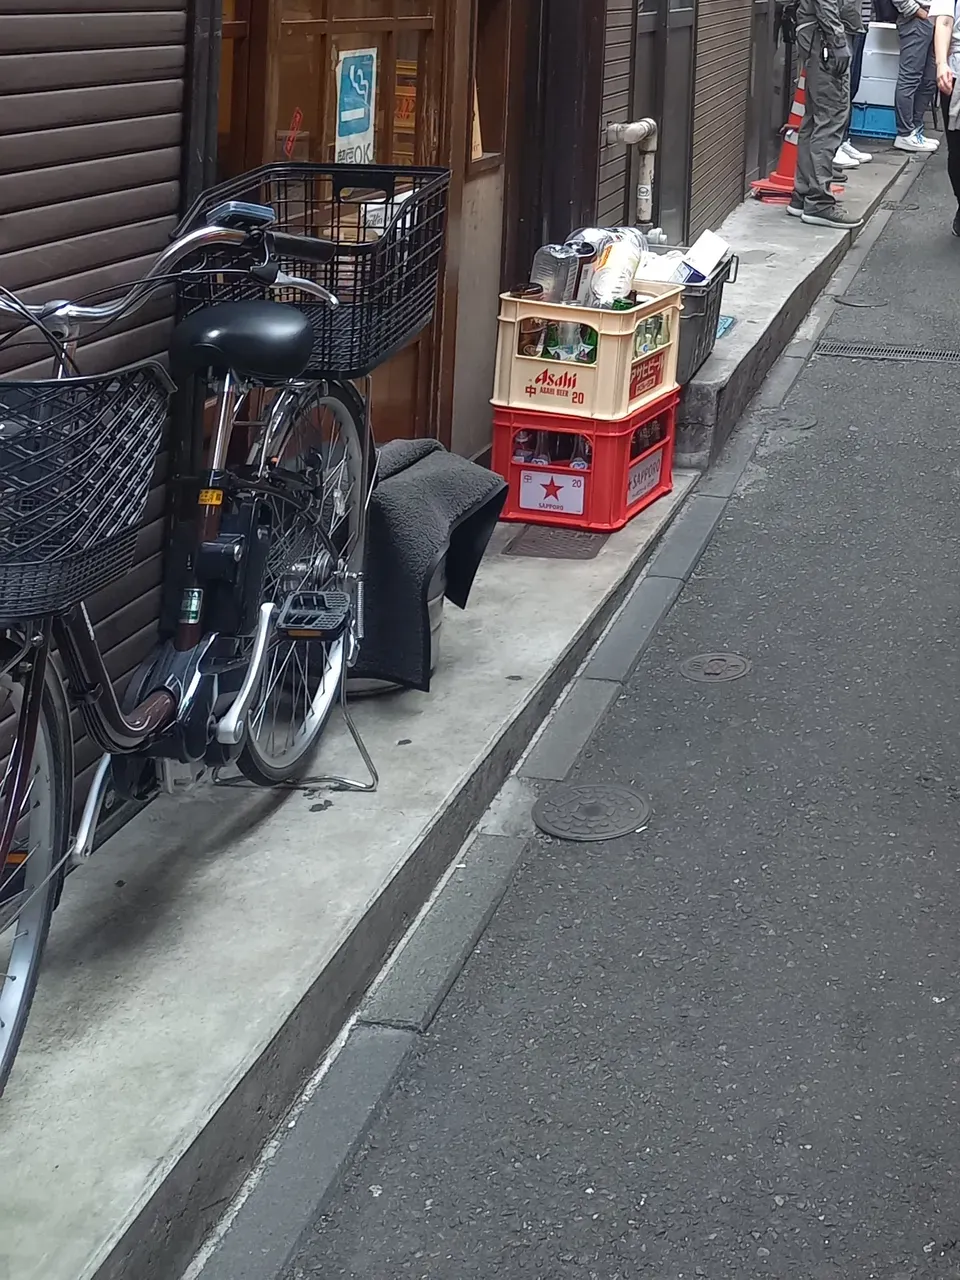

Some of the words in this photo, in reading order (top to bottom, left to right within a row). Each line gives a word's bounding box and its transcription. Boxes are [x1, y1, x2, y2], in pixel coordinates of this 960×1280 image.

[535, 368, 578, 389] Asahi
[525, 385, 536, 397] 中
[540, 386, 555, 395] ASAHI
[557, 388, 569, 397] BEER
[572, 391, 584, 404] 20
[572, 479, 582, 488] 20
[539, 502, 564, 511] SAPPORO
